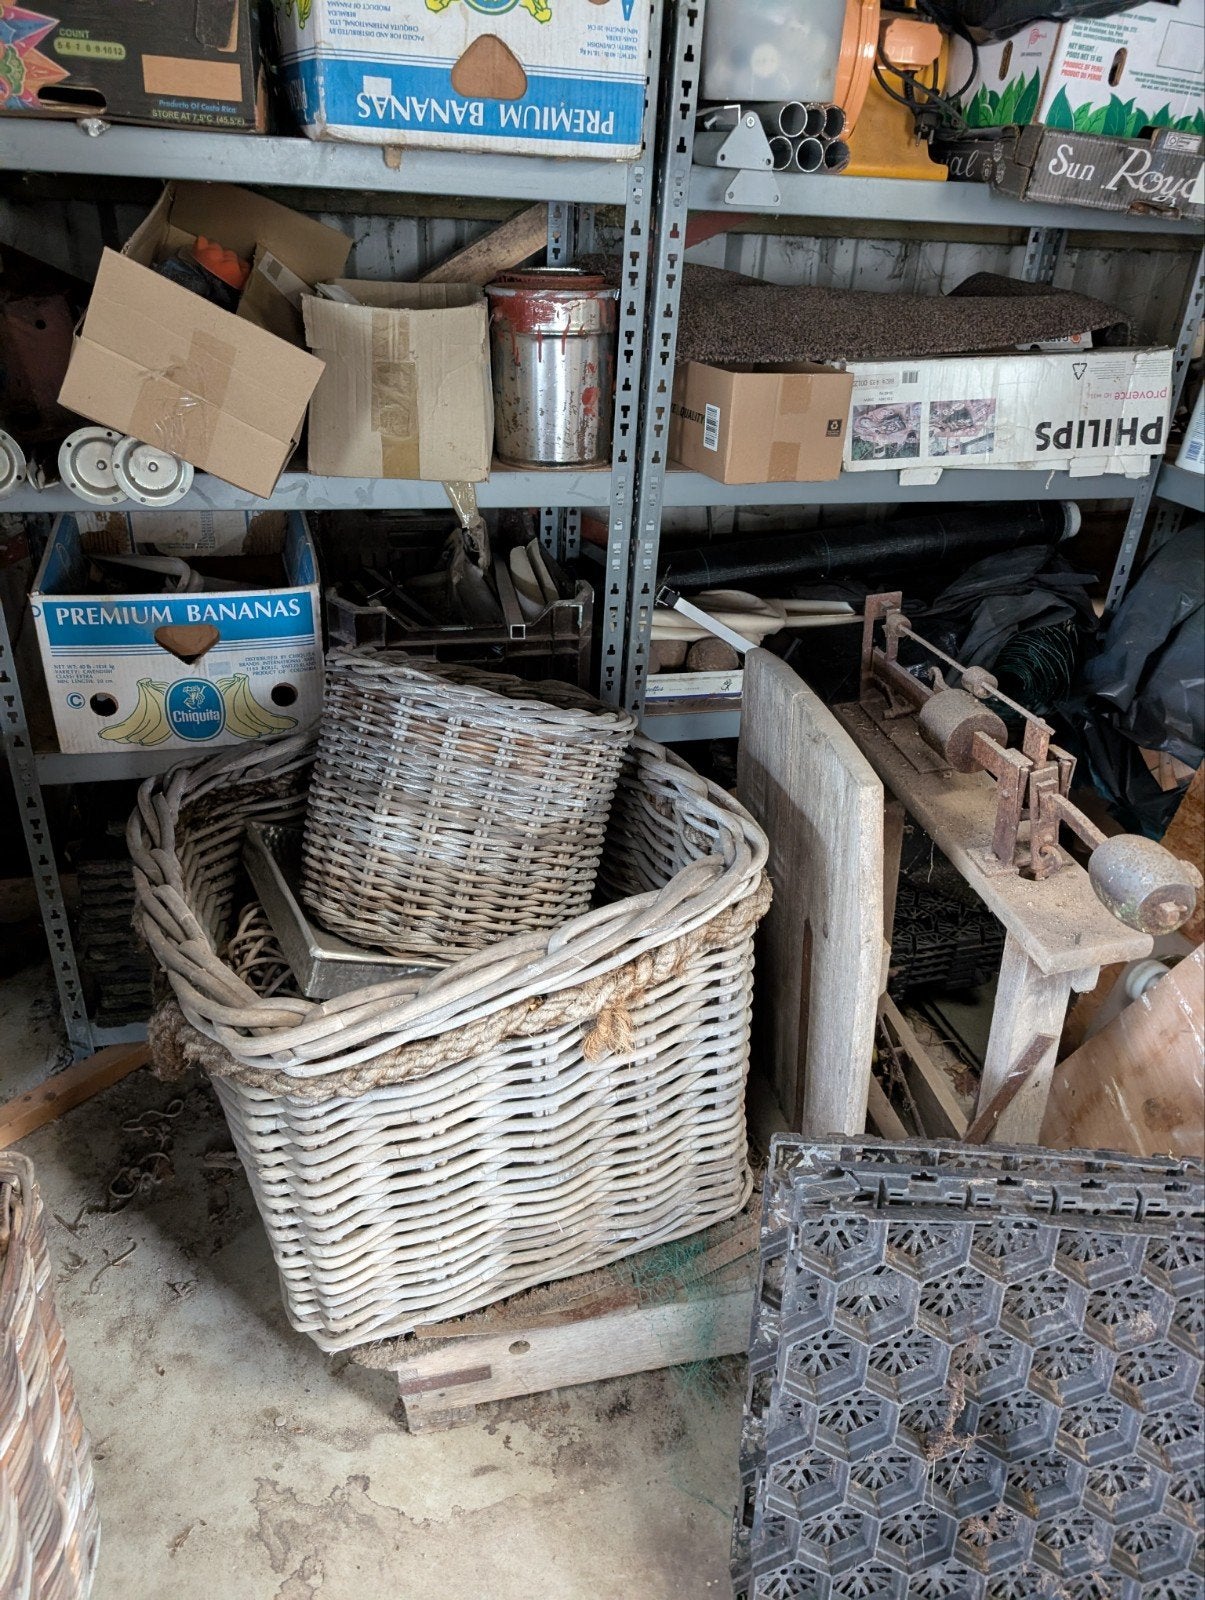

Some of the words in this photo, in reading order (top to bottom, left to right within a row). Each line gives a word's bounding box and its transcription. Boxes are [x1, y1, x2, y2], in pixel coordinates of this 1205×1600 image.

[327, 0, 352, 9] PANAMA
[362, 4, 391, 12] PRODUCT
[59, 28, 90, 39] COUNT
[152, 109, 179, 119] STORE
[180, 112, 191, 120] AT
[200, 104, 220, 112] Costa
[221, 105, 237, 113] Rica
[356, 92, 484, 127] BANANAS
[500, 103, 614, 135] PREMIUM
[1049, 144, 1095, 182] Sun
[1113, 387, 1168, 401] provence
[1036, 416, 1164, 452] PHILIPS
[55, 606, 173, 626] PREMIUM
[187, 598, 301, 622] BANANAS
[172, 709, 221, 724] Chiquita
